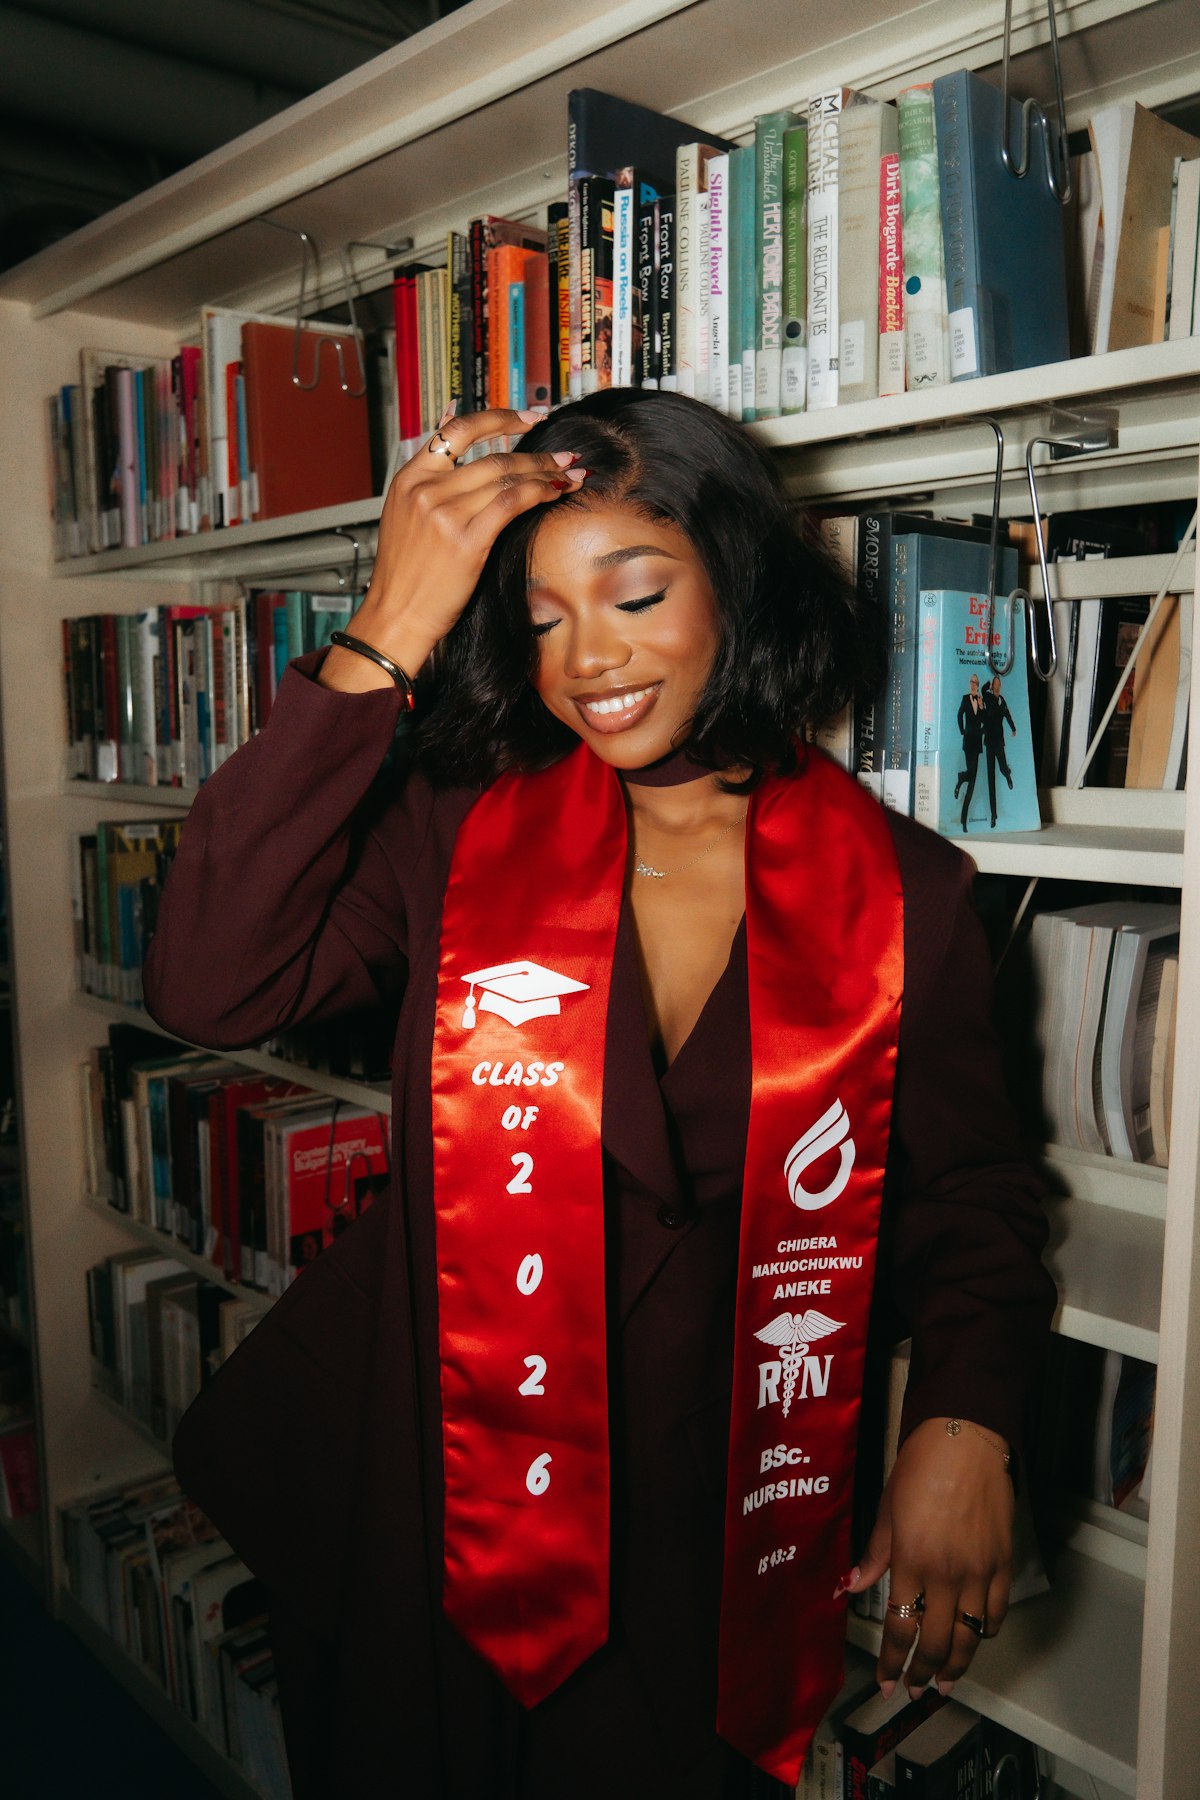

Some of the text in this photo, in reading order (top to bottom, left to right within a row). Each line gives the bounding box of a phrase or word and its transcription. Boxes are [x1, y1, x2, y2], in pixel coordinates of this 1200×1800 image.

[763, 129, 777, 201] Unsinkable
[770, 142, 784, 170] The
[808, 96, 822, 196] BENTINE
[820, 93, 839, 193] MICHAEL
[679, 158, 691, 221] PAULINE
[788, 150, 797, 192] GODFREY
[618, 196, 630, 249] Russia
[708, 173, 723, 243] Slightly
[788, 207, 797, 240] SPECIAL
[559, 222, 570, 280] THEATRE
[640, 216, 652, 262] Front
[679, 227, 691, 292] COLLINS
[699, 223, 709, 268] PAULINE
[762, 201, 782, 289] HERMIONE
[788, 244, 796, 264] TIME
[884, 163, 900, 332] Dirk Bogarde Backclo
[582, 248, 591, 291] BRIGHT
[618, 252, 628, 272] on
[640, 265, 652, 301] Row
[710, 247, 723, 296] Foxed
[811, 215, 828, 337] THE RELUCTANT JES
[560, 288, 570, 330] INSIDE
[618, 276, 630, 321] Reels
[660, 213, 673, 377] Front Row Beryl Bainbr
[699, 272, 709, 316] COLLINS
[788, 268, 797, 318] REMEMBER
[641, 314, 651, 339] Beryl
[711, 314, 721, 349] Angela
[762, 292, 781, 350] BADDEL
[560, 338, 570, 362] OUT
[641, 340, 651, 381] Bainbri
[863, 517, 880, 578] MORE
[471, 1060, 565, 1087] CLASS
[501, 1104, 540, 1131] OF
[777, 1236, 838, 1253] CHIDERA
[752, 1256, 863, 1279] MAKUOCHUKWU
[772, 1279, 832, 1300] ANEKE
[757, 1354, 835, 1410] RN
[743, 1475, 830, 1516] NURSING
[757, 1545, 797, 1575] IS 43:2
